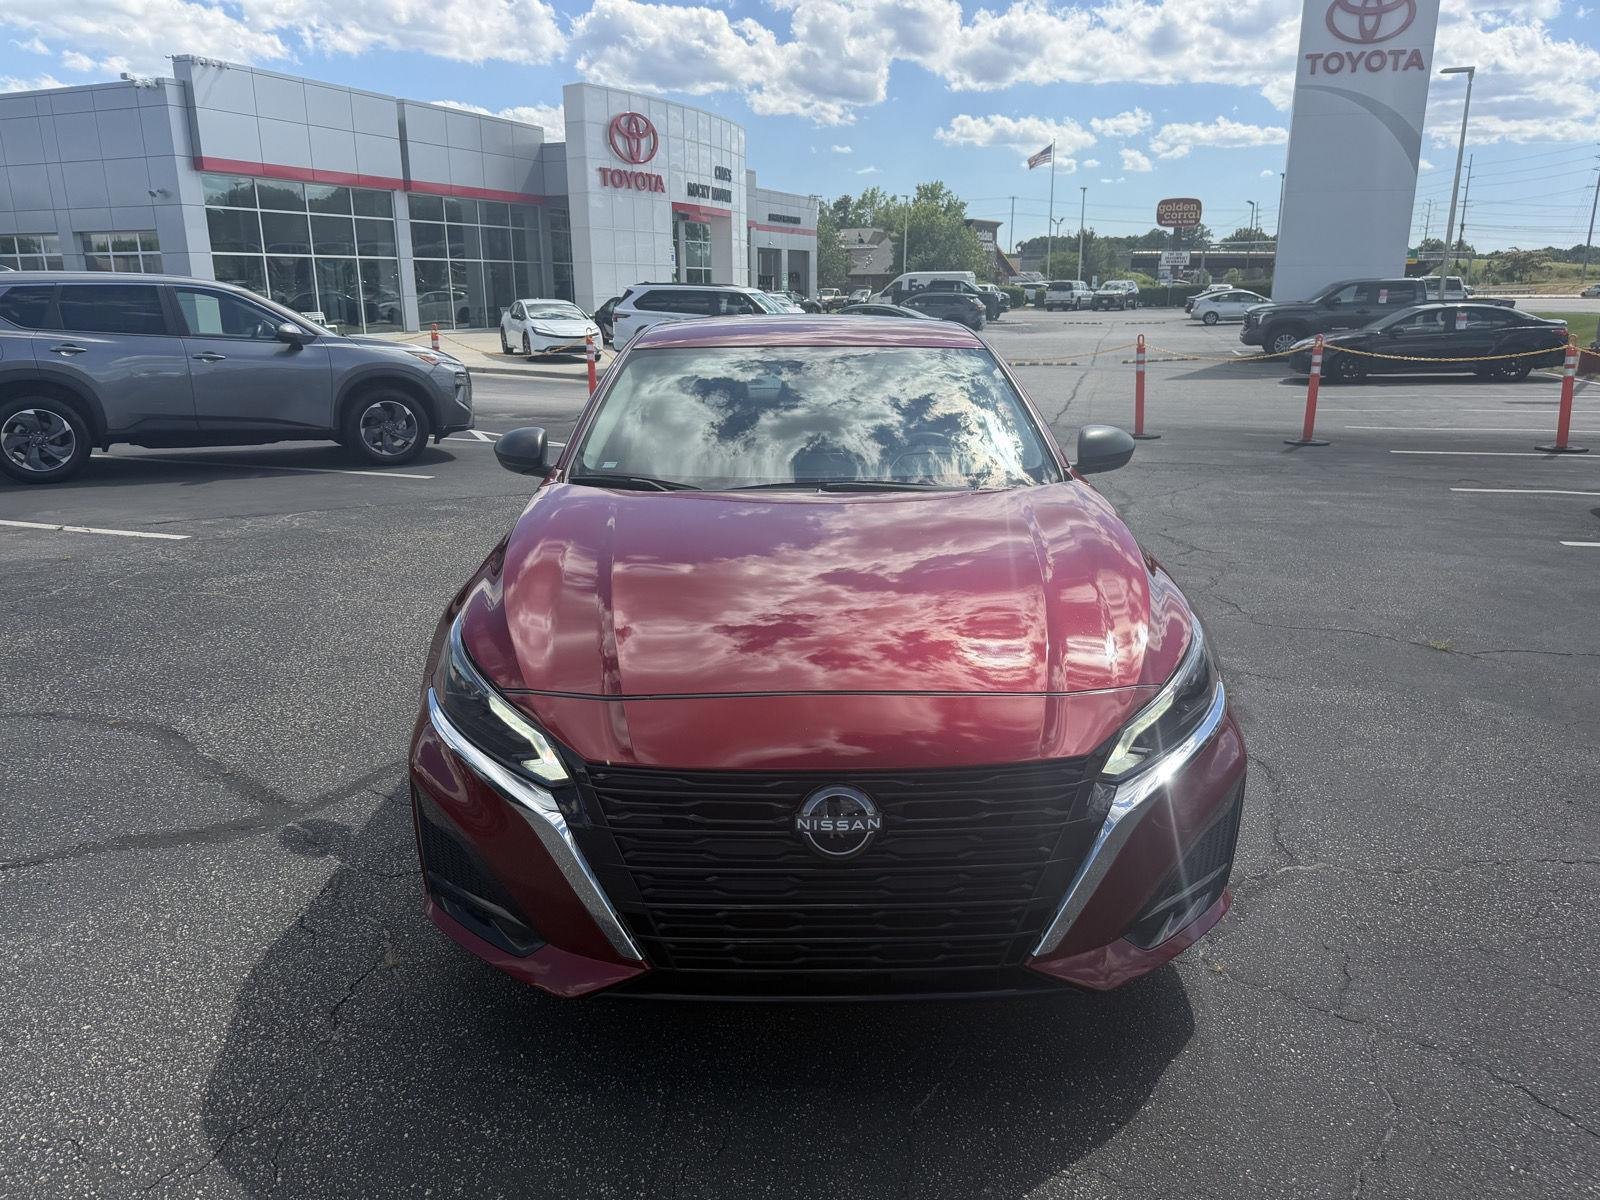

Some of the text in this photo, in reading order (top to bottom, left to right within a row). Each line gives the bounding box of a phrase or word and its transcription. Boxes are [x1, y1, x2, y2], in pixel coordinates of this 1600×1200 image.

[1305, 48, 1425, 75] TOYOTA
[598, 166, 666, 193] TOYOTA
[1158, 202, 1197, 214] golden
[1163, 210, 1200, 220] corral
[797, 817, 881, 831] NISSAN
